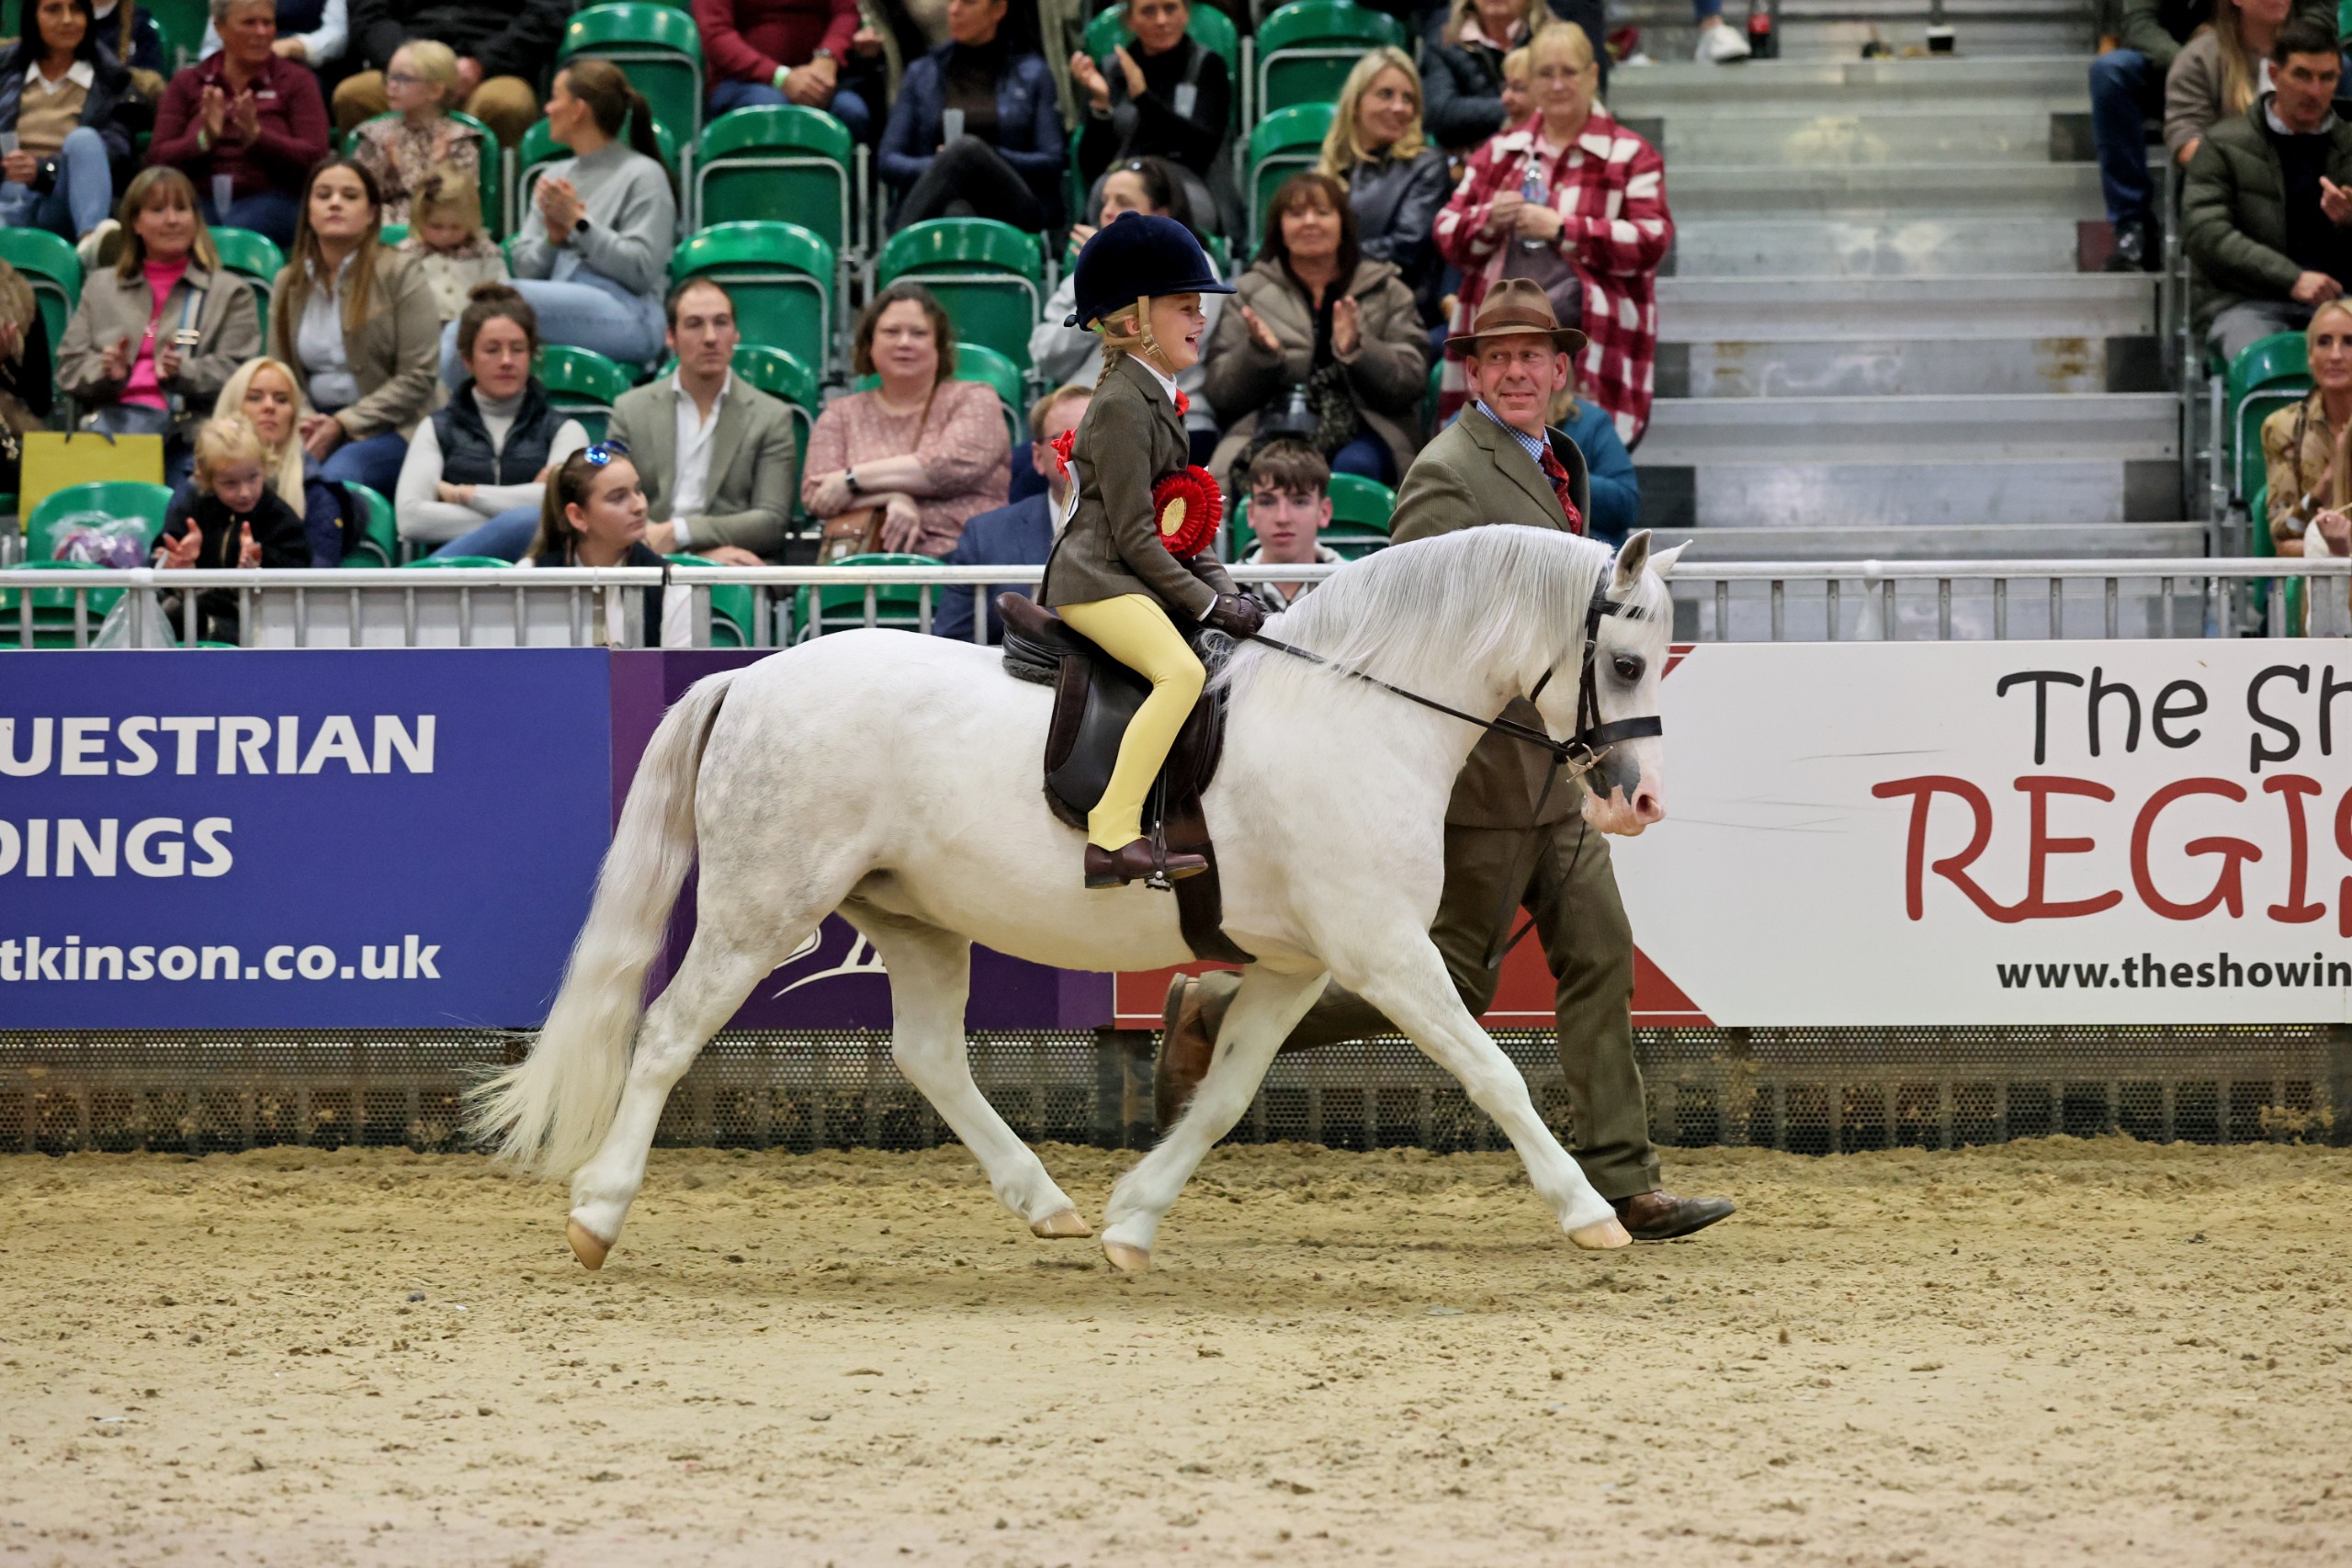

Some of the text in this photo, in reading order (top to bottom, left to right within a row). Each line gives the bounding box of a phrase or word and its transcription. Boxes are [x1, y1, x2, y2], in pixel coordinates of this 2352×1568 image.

[0, 715, 436, 777] UESTRIAN
[1996, 666, 2208, 765] The
[1871, 774, 2352, 938] REGI
[0, 934, 441, 982] tkinson.co.uk
[1996, 952, 2352, 988] www.theshowin
